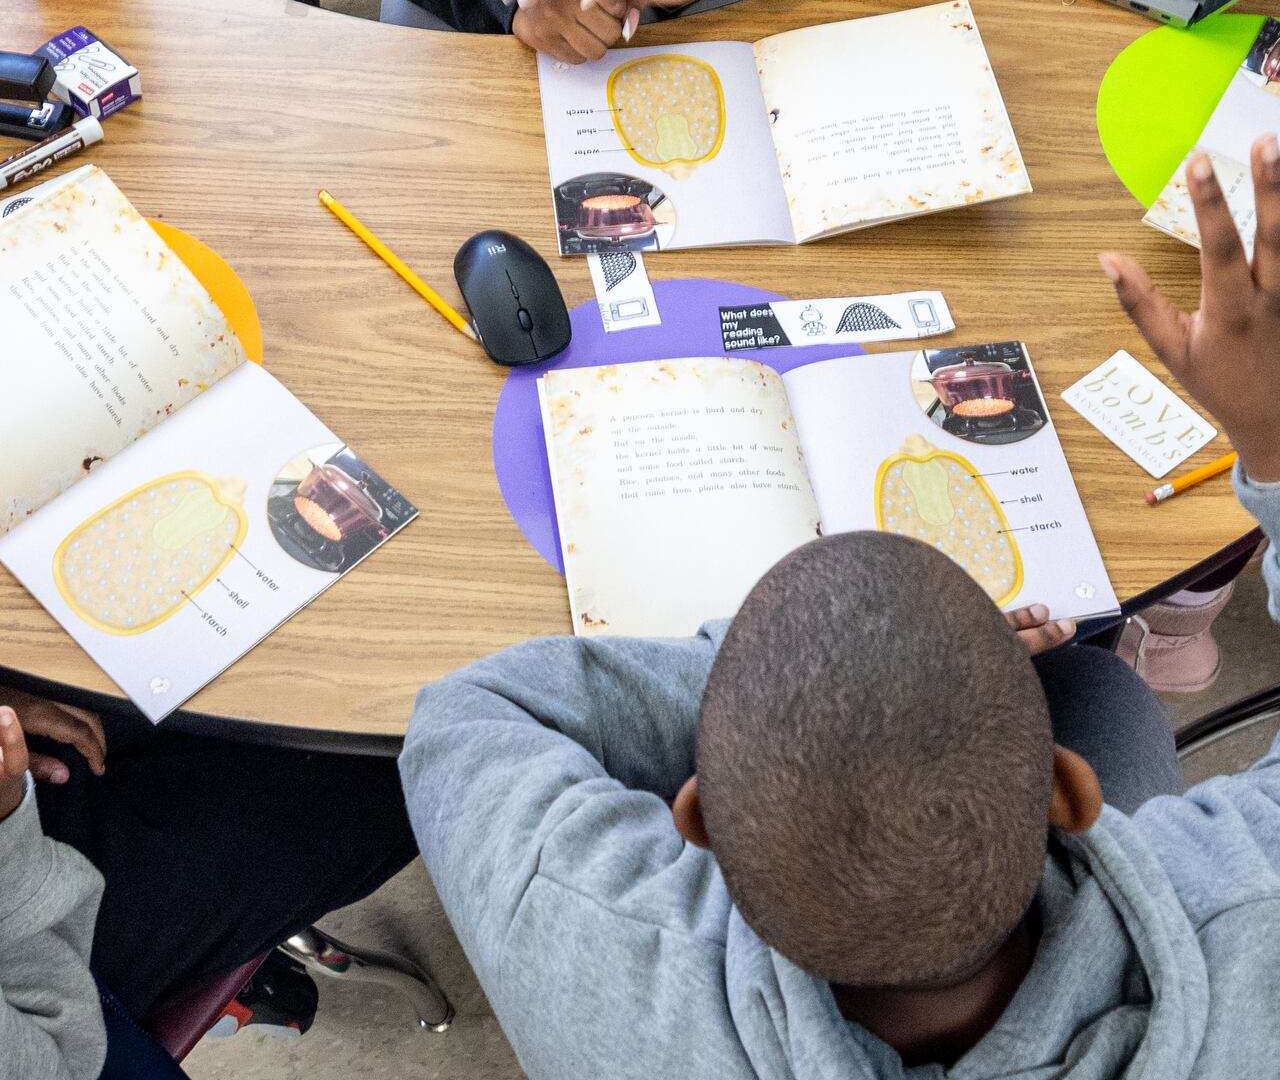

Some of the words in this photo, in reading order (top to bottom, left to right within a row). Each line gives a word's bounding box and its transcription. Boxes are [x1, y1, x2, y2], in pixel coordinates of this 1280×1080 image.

[565, 108, 594, 117] starch
[576, 126, 597, 136] shell
[573, 146, 601, 156] water
[721, 310, 748, 321] What
[750, 308, 774, 319] does
[723, 321, 738, 332] my
[724, 327, 763, 340] reading
[725, 337, 756, 347] sound
[757, 334, 780, 345] like?
[751, 407, 762, 415] dry
[1104, 364, 1204, 449] LOVE
[1083, 378, 1181, 461] bombs
[1072, 391, 1127, 439] KINDNESS
[1127, 437, 1164, 470] CARDS
[1010, 465, 1039, 476] water
[1020, 494, 1043, 505] shell
[1030, 520, 1062, 531] starch
[255, 569, 280, 592] water
[228, 589, 248, 610] shell
[201, 611, 228, 637] starch
